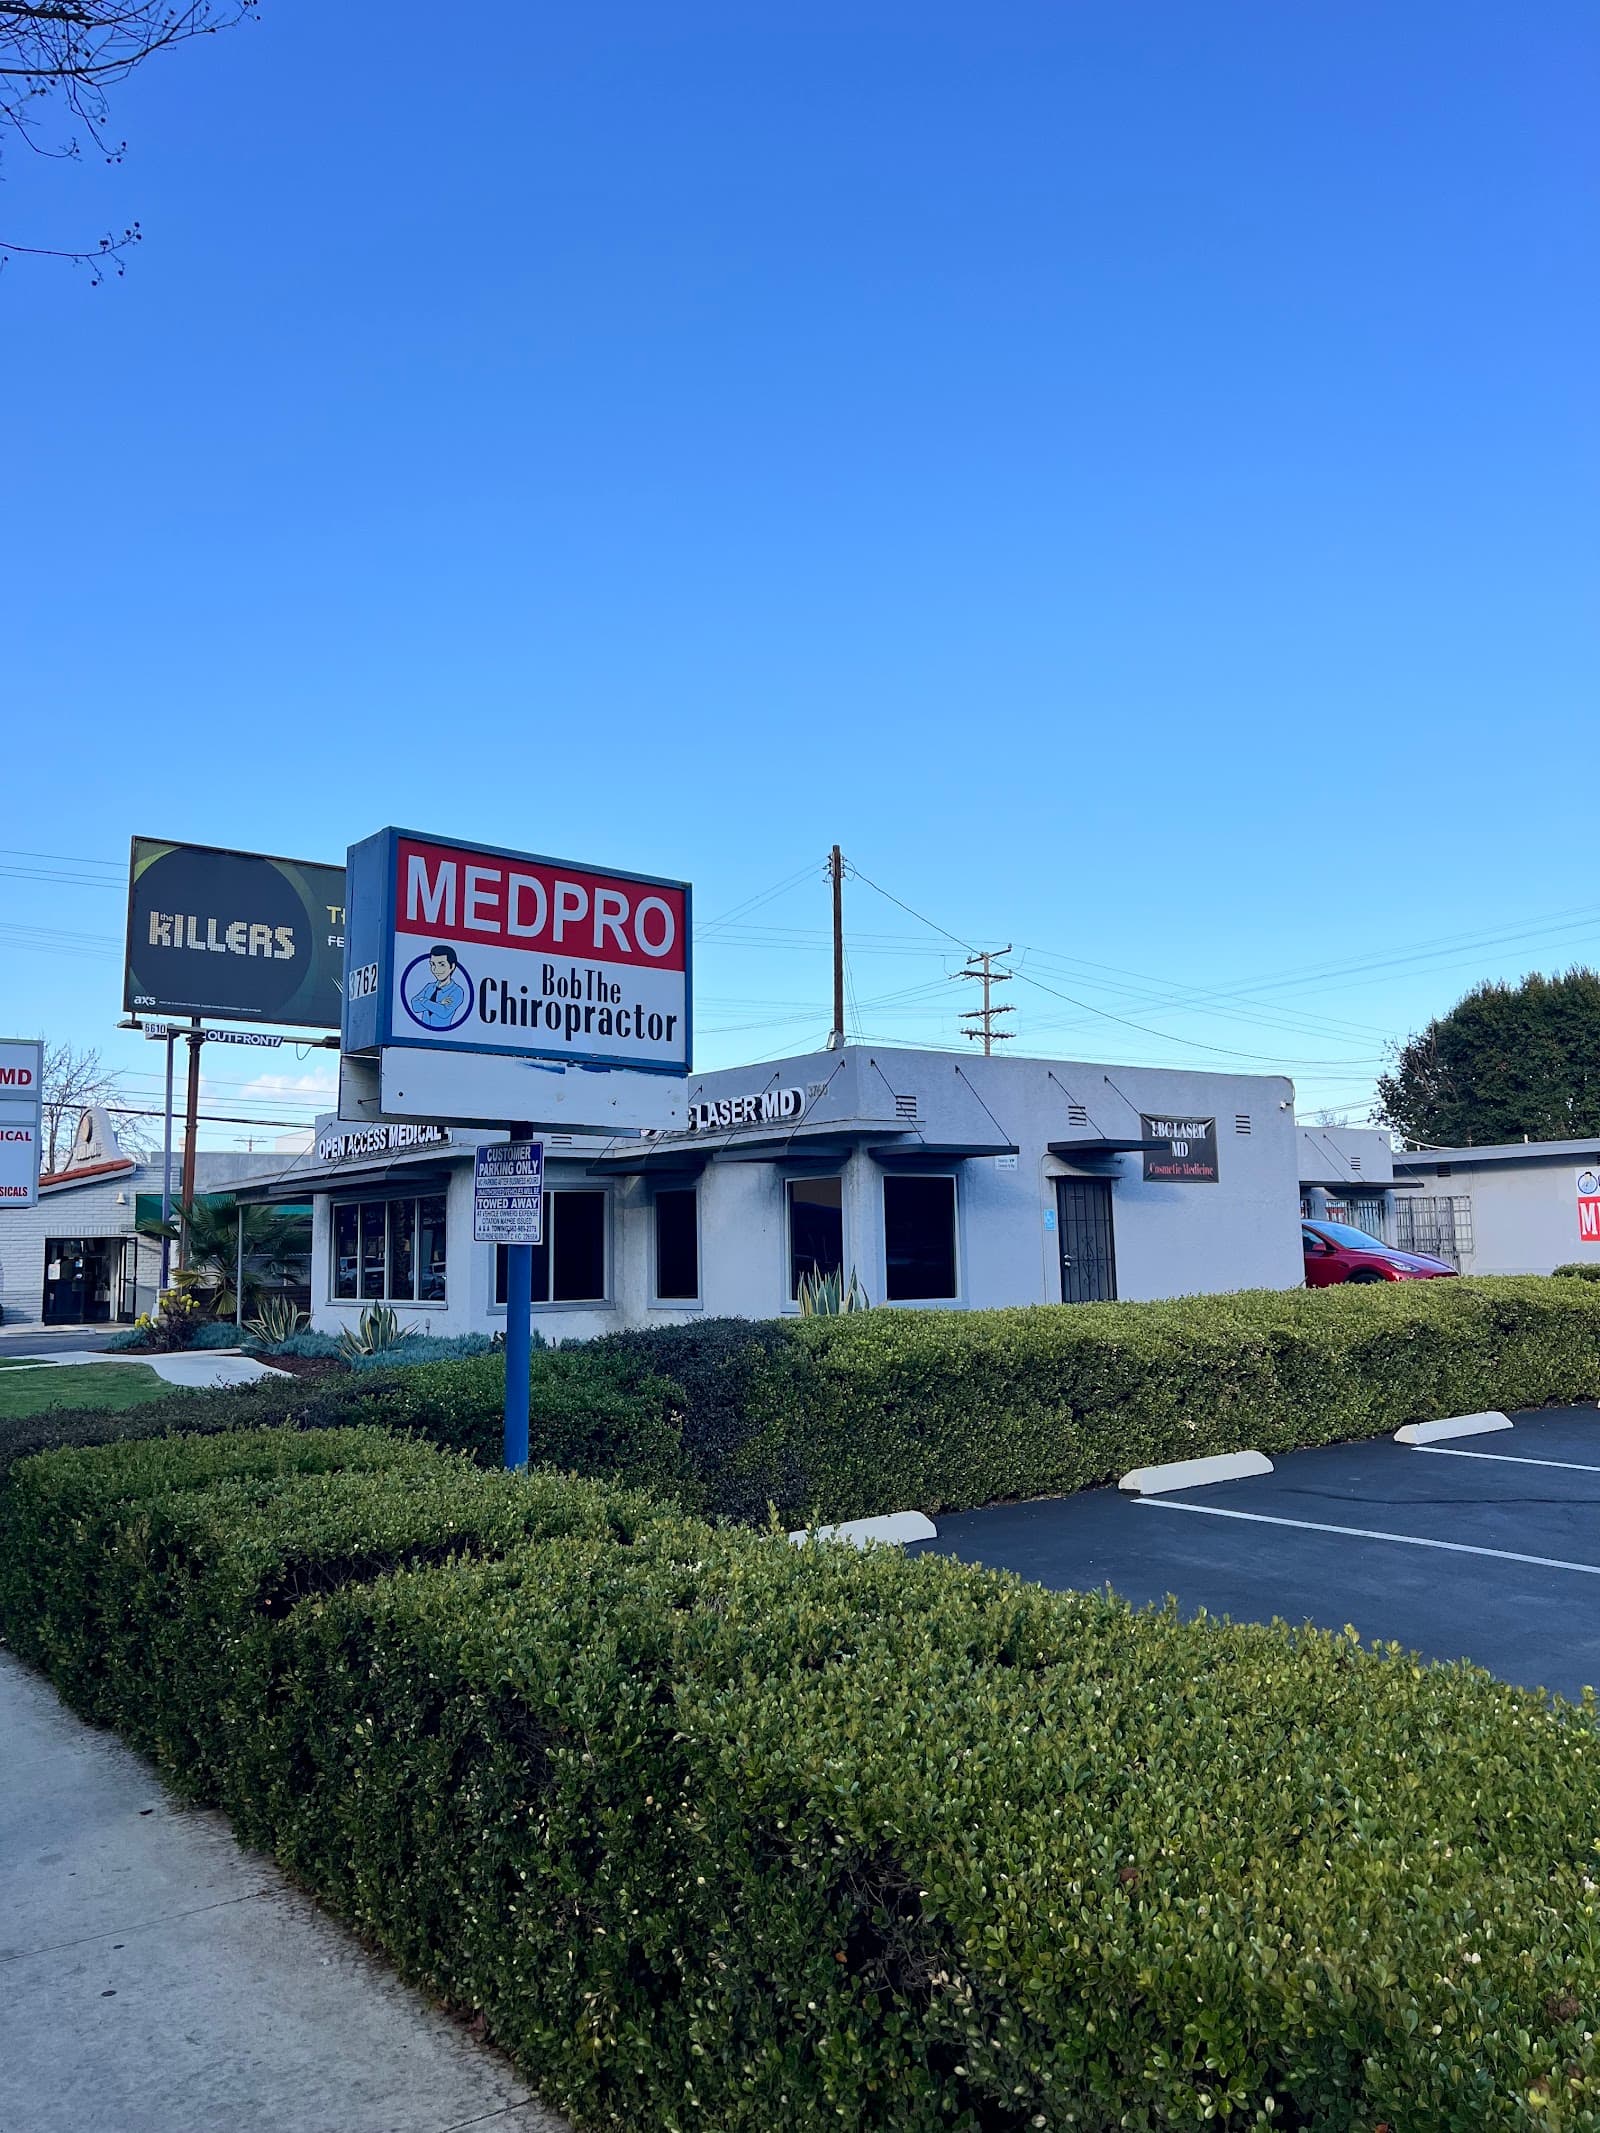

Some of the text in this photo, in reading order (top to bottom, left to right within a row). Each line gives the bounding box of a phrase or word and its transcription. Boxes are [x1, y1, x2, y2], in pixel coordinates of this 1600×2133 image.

[406, 854, 675, 958] MEDPRO
[350, 964, 378, 999] 3762
[479, 977, 678, 1042] Chiropractor
[0, 1068, 32, 1086] MD
[697, 1097, 757, 1128] LASER
[761, 1089, 795, 1118] MD
[1173, 1122, 1206, 1139] LASER
[319, 1135, 346, 1159] OPEN
[347, 1126, 387, 1155] ACCESS
[388, 1124, 442, 1148] MEDICAL
[1171, 1141, 1189, 1157] MD
[487, 1146, 531, 1162] CUSTOMER
[479, 1160, 538, 1176] PARKING ONLY
[1149, 1162, 1213, 1175] Cosmetic Medicine
[478, 1197, 538, 1209] TOWED AWAY
